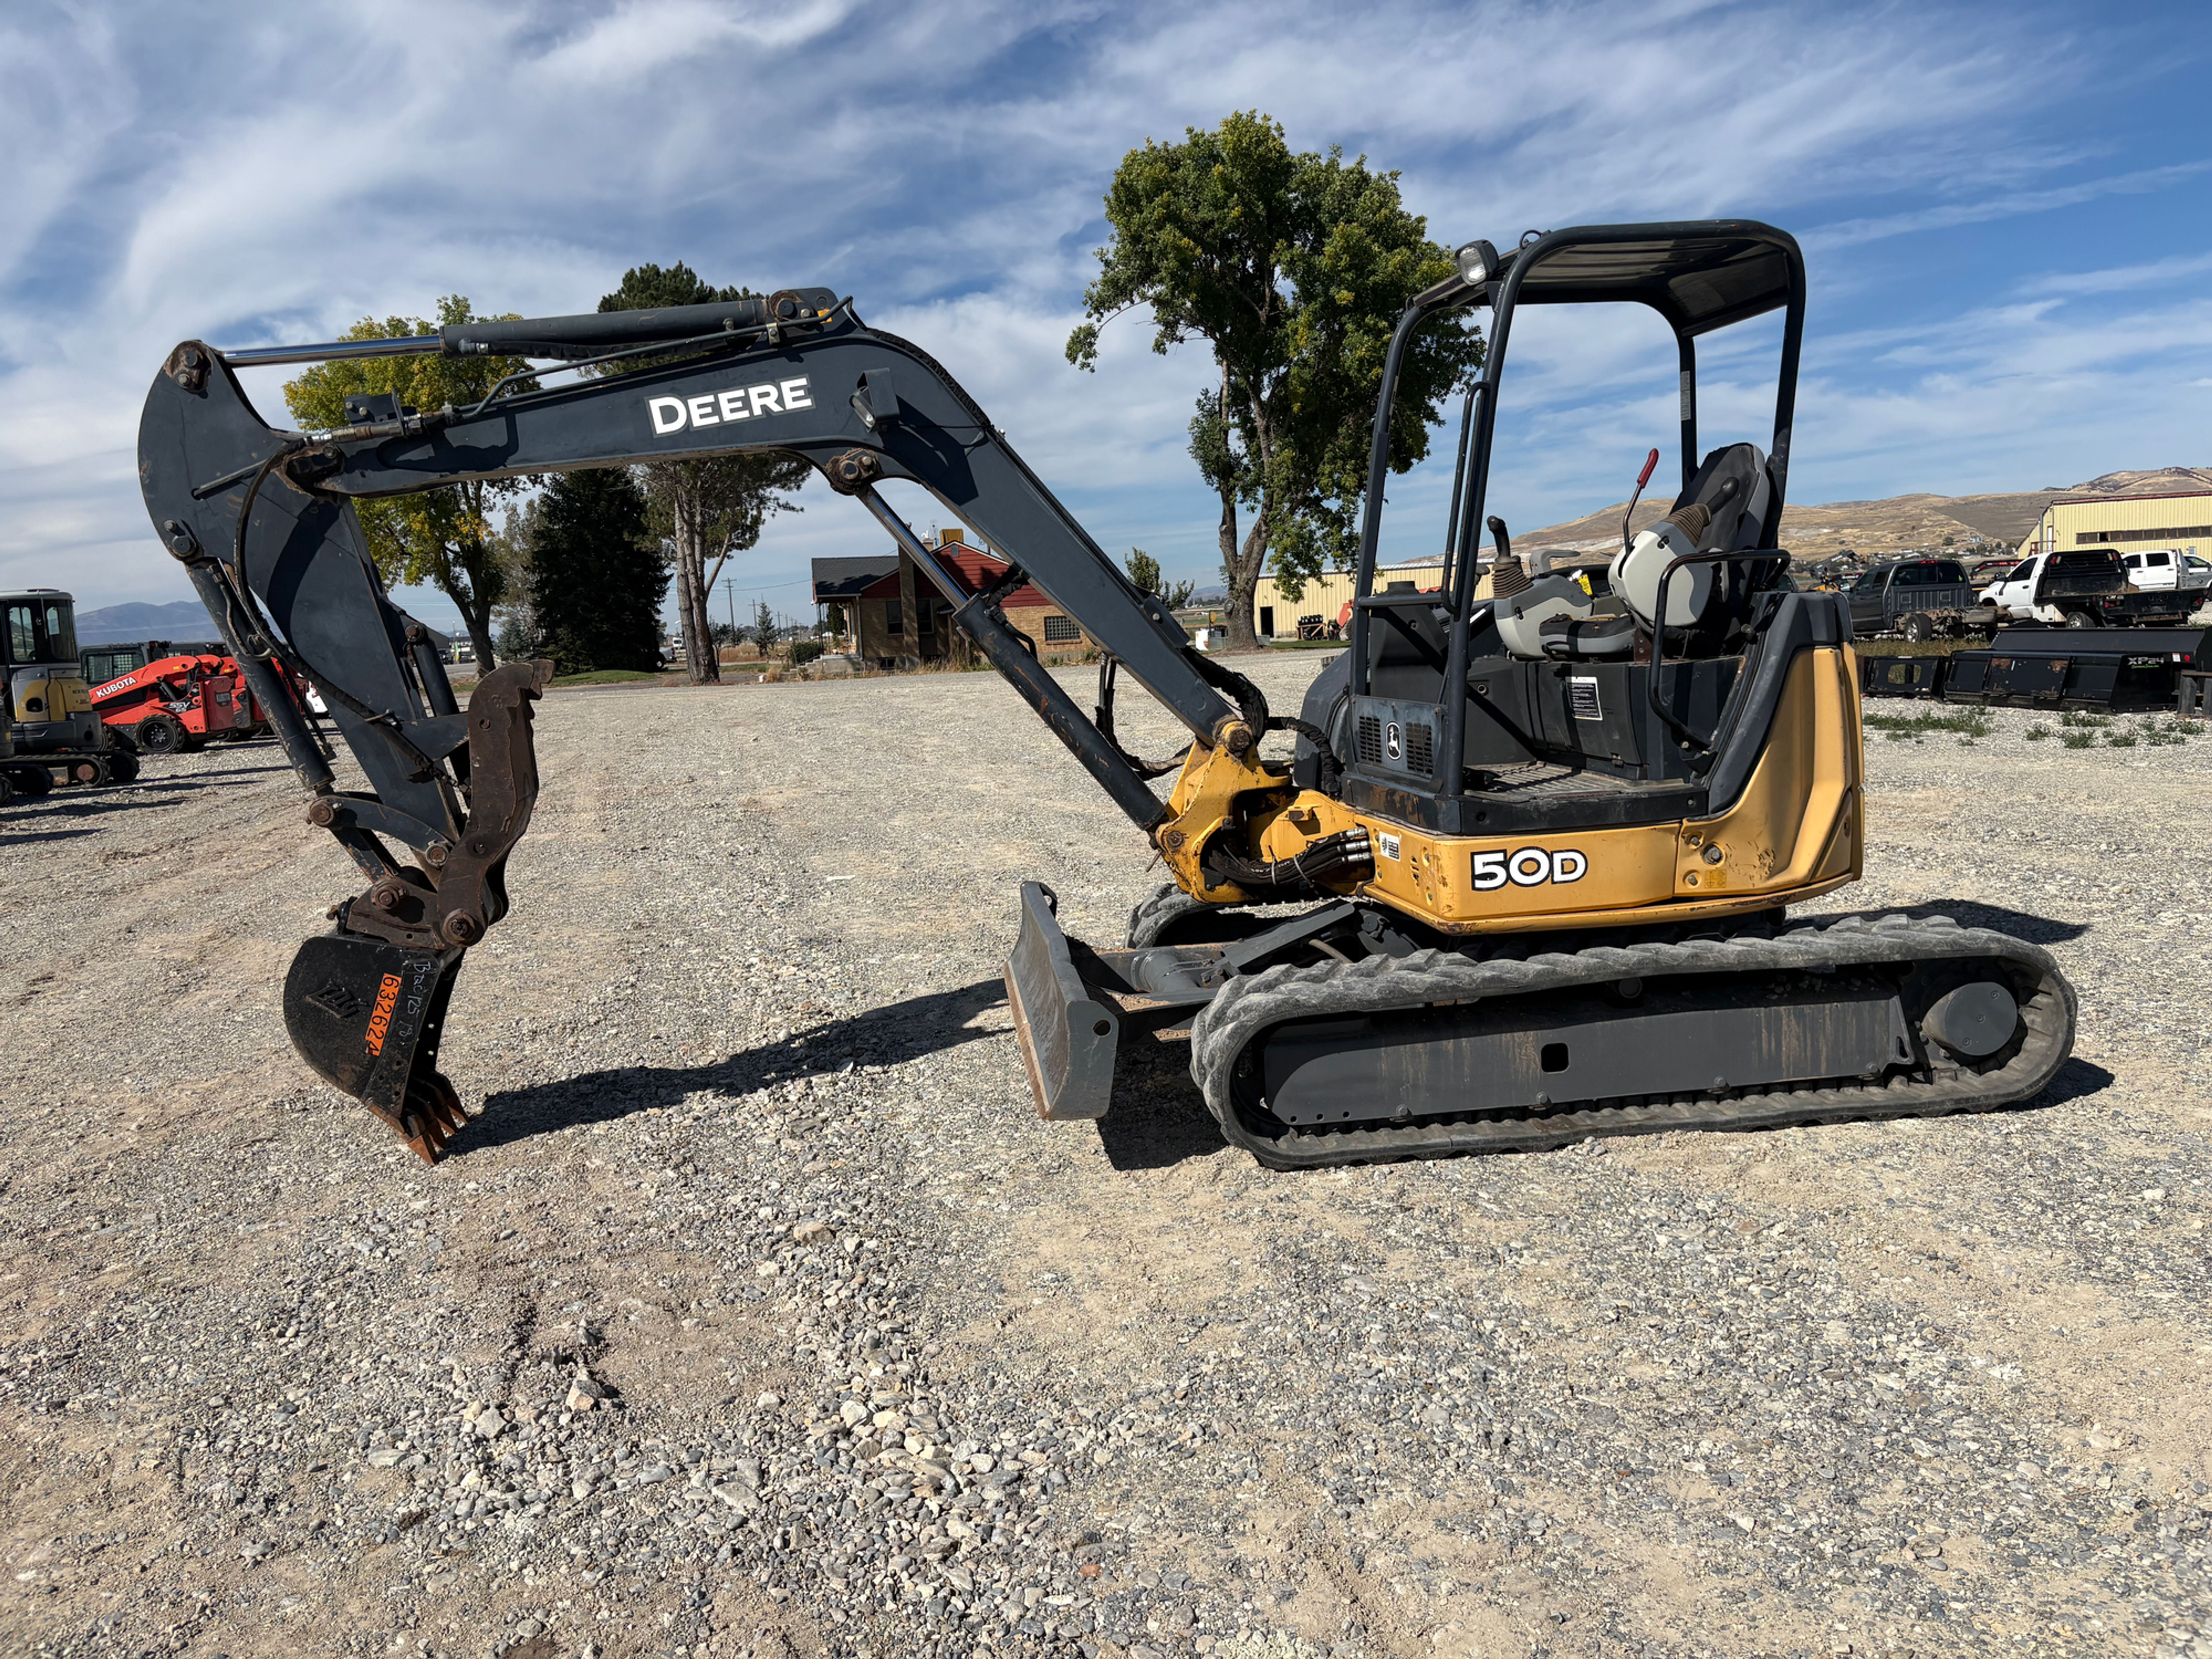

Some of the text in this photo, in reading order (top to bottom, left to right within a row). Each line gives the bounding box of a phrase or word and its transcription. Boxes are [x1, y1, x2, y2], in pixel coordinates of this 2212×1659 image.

[649, 378, 812, 434] DEERE
[2128, 656, 2164, 665] XP24
[96, 677, 137, 698] KUBOTA
[1471, 847, 1588, 891] 50D
[367, 977, 399, 1053] 632624
